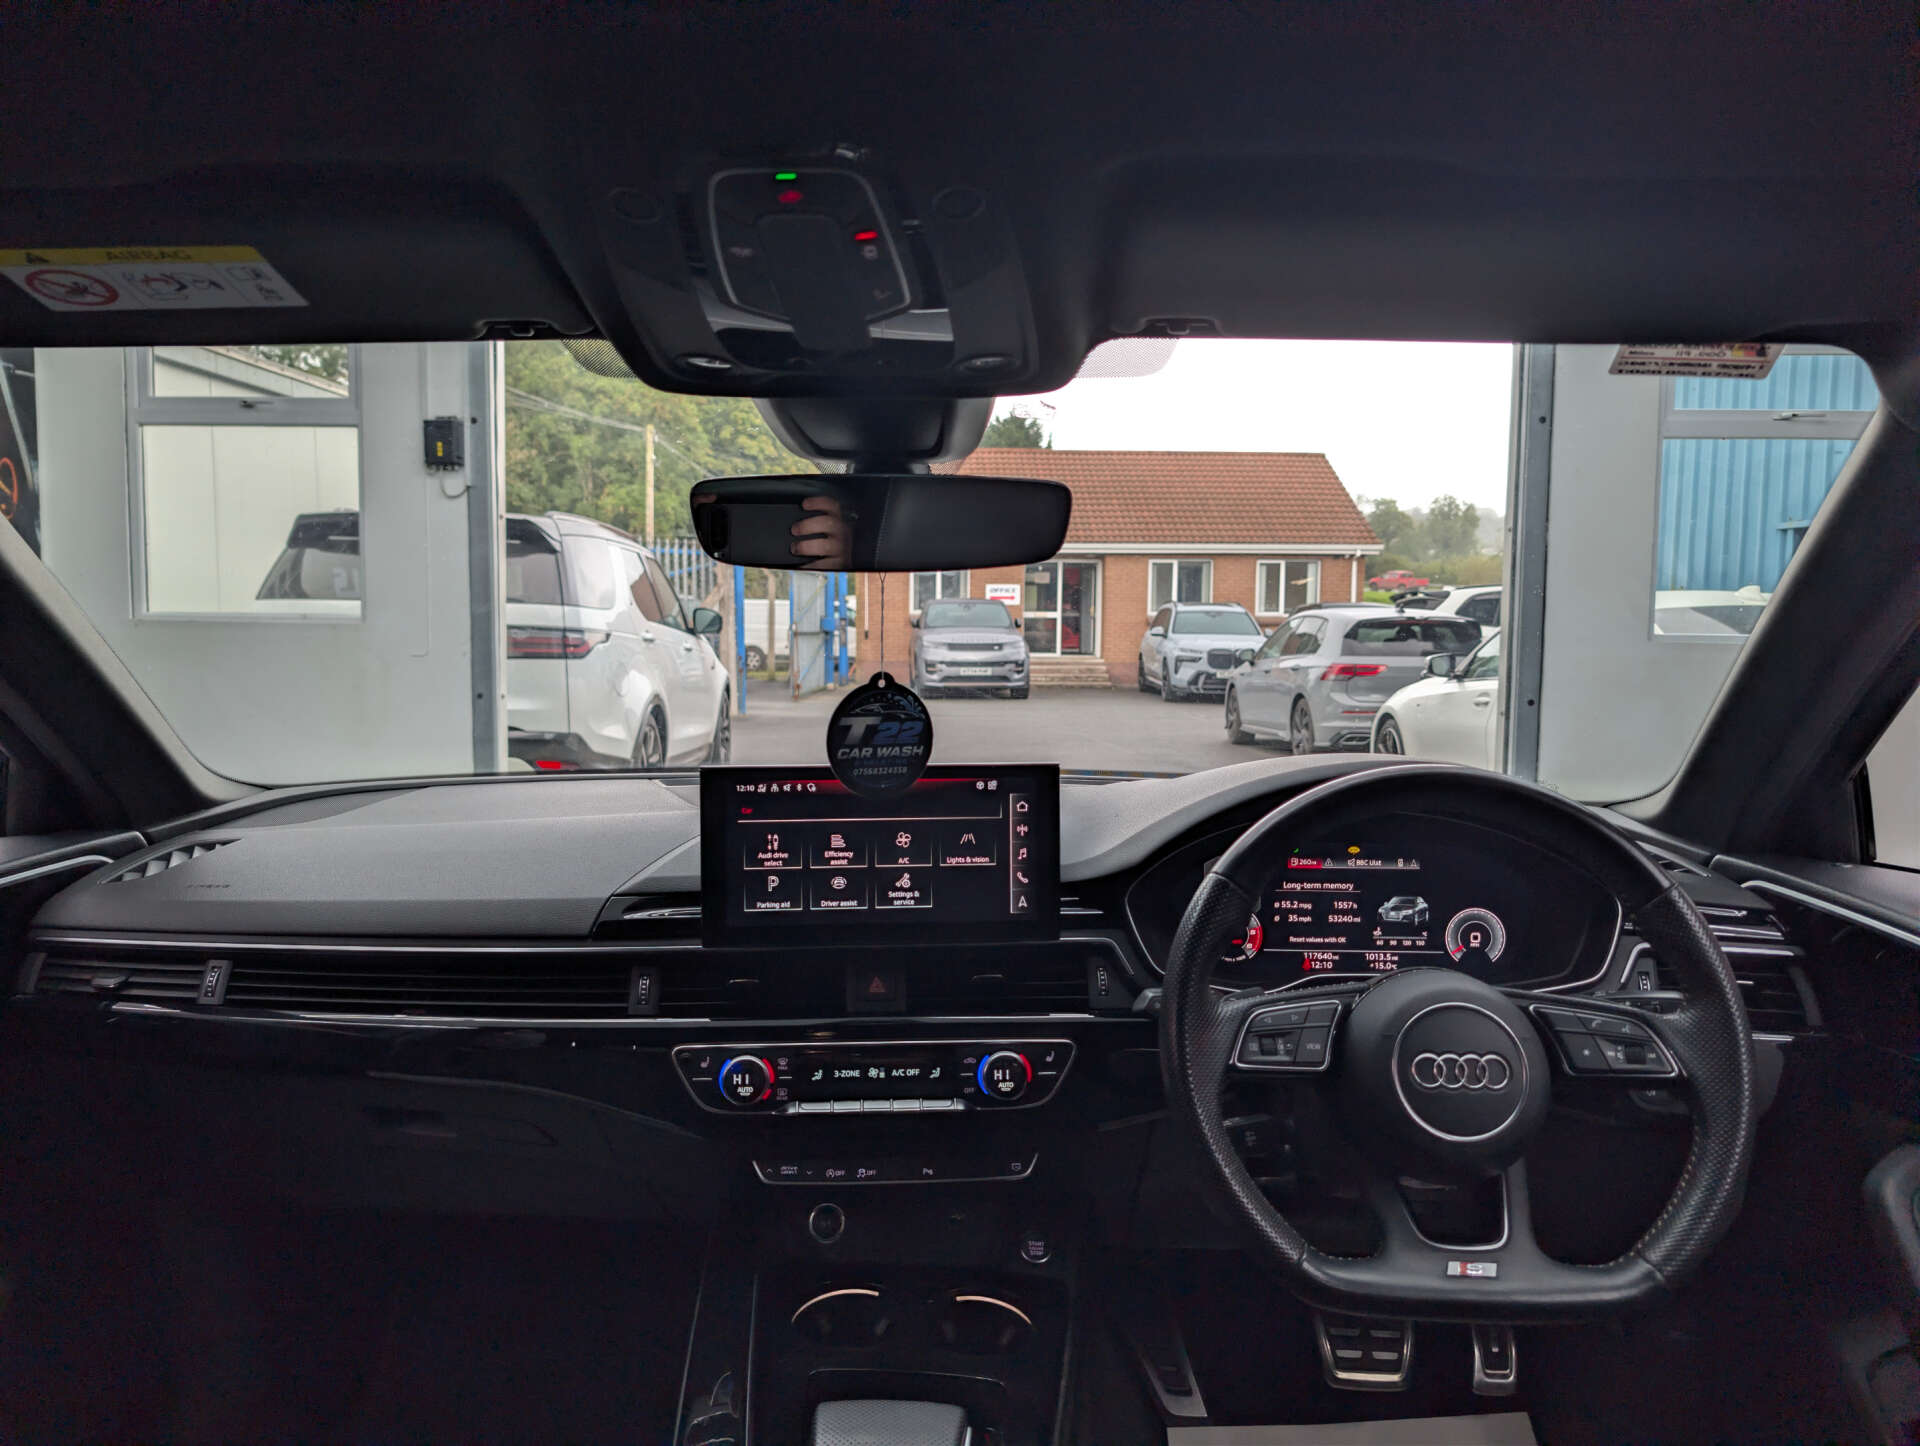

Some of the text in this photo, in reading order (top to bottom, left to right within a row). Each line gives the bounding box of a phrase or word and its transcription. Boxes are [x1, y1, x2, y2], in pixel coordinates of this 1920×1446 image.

[838, 716, 925, 745] T22
[836, 744, 924, 760] CAR WASH
[736, 784, 755, 792] 12:10
[824, 851, 854, 860] Efficiency
[830, 858, 849, 866] assist
[946, 857, 965, 865] Lights
[1283, 882, 1354, 891] Long-term memory
[888, 891, 913, 899] Settings
[756, 901, 780, 909] Parking
[1281, 901, 1298, 909] 55.2
[1287, 914, 1298, 922] 35
[1311, 961, 1333, 969] 12:10
[833, 1070, 861, 1078] 3-ZONE
[891, 1069, 905, 1077] A/C
